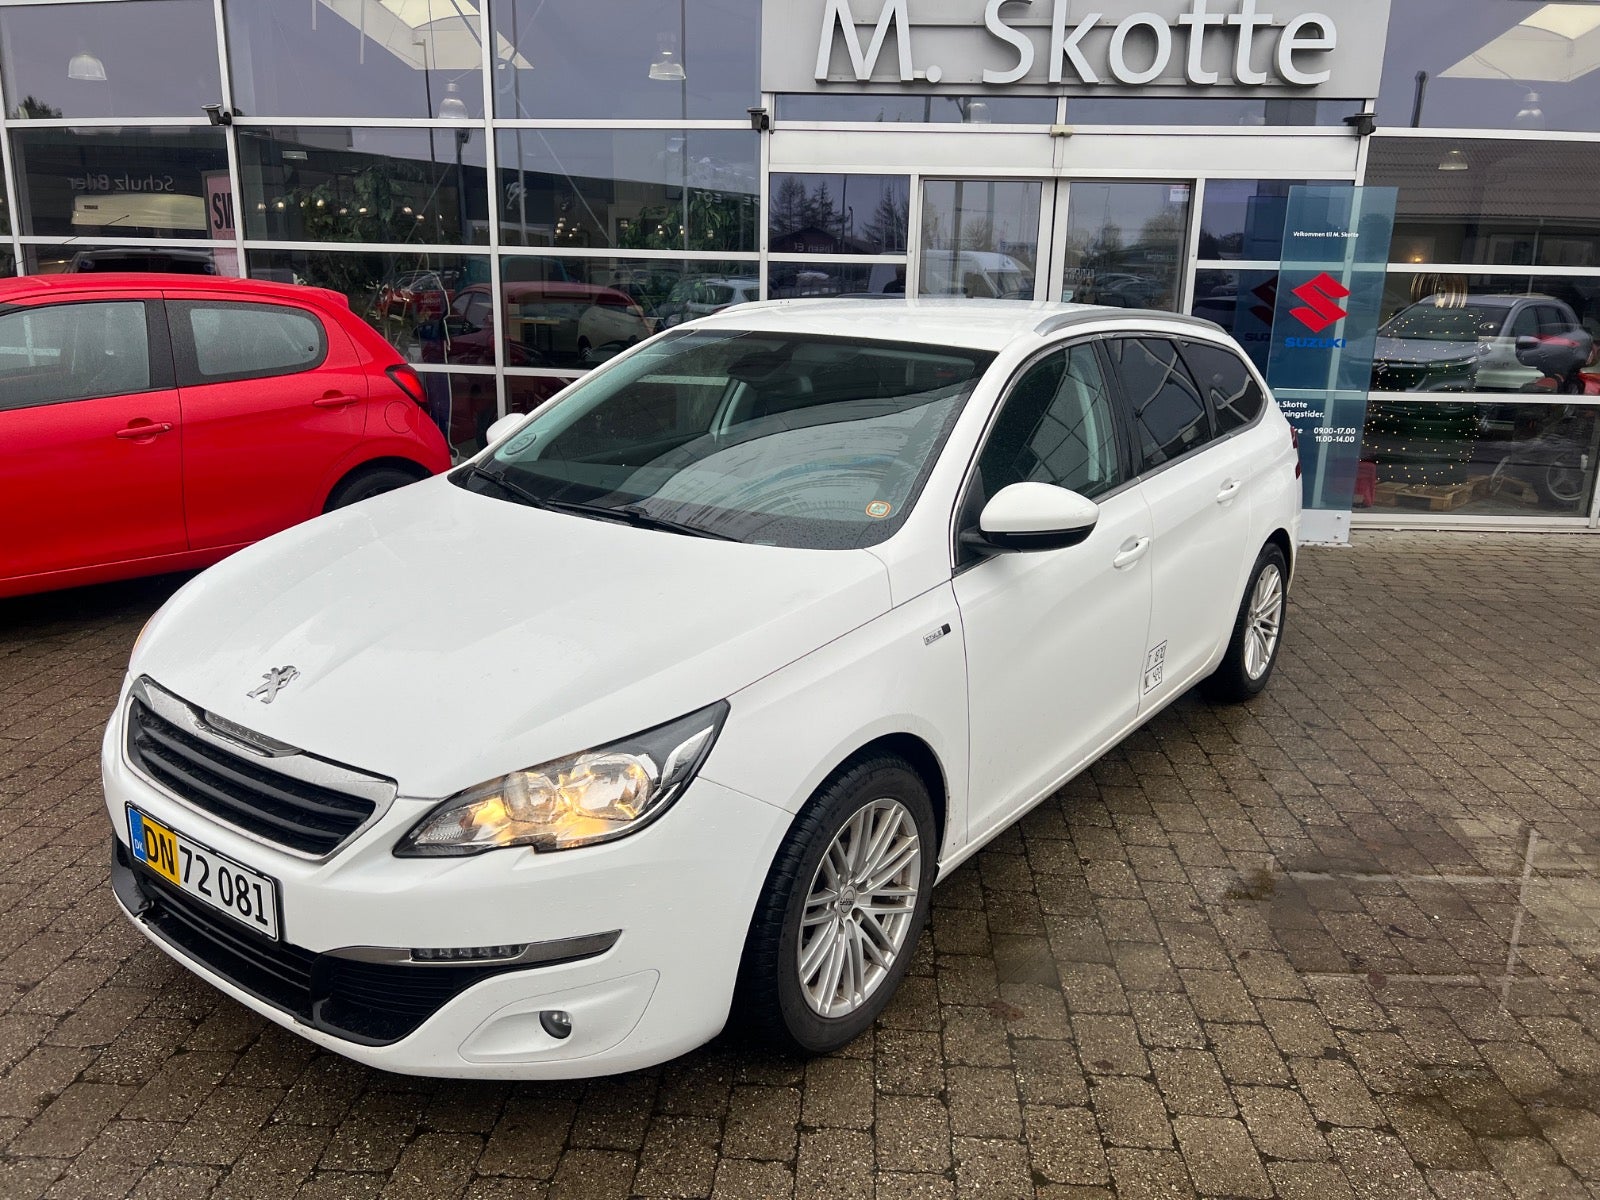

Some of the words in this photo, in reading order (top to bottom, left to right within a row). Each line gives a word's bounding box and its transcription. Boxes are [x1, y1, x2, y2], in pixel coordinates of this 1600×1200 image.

[814, 0, 942, 83] M.
[982, 0, 1337, 86] Skotte
[1284, 337, 1347, 349] SUZUKI
[1284, 410, 1325, 419] ningstider.
[134, 838, 144, 853] DK
[143, 824, 175, 876] DN
[179, 844, 212, 898] 72
[218, 866, 268, 926] 081
